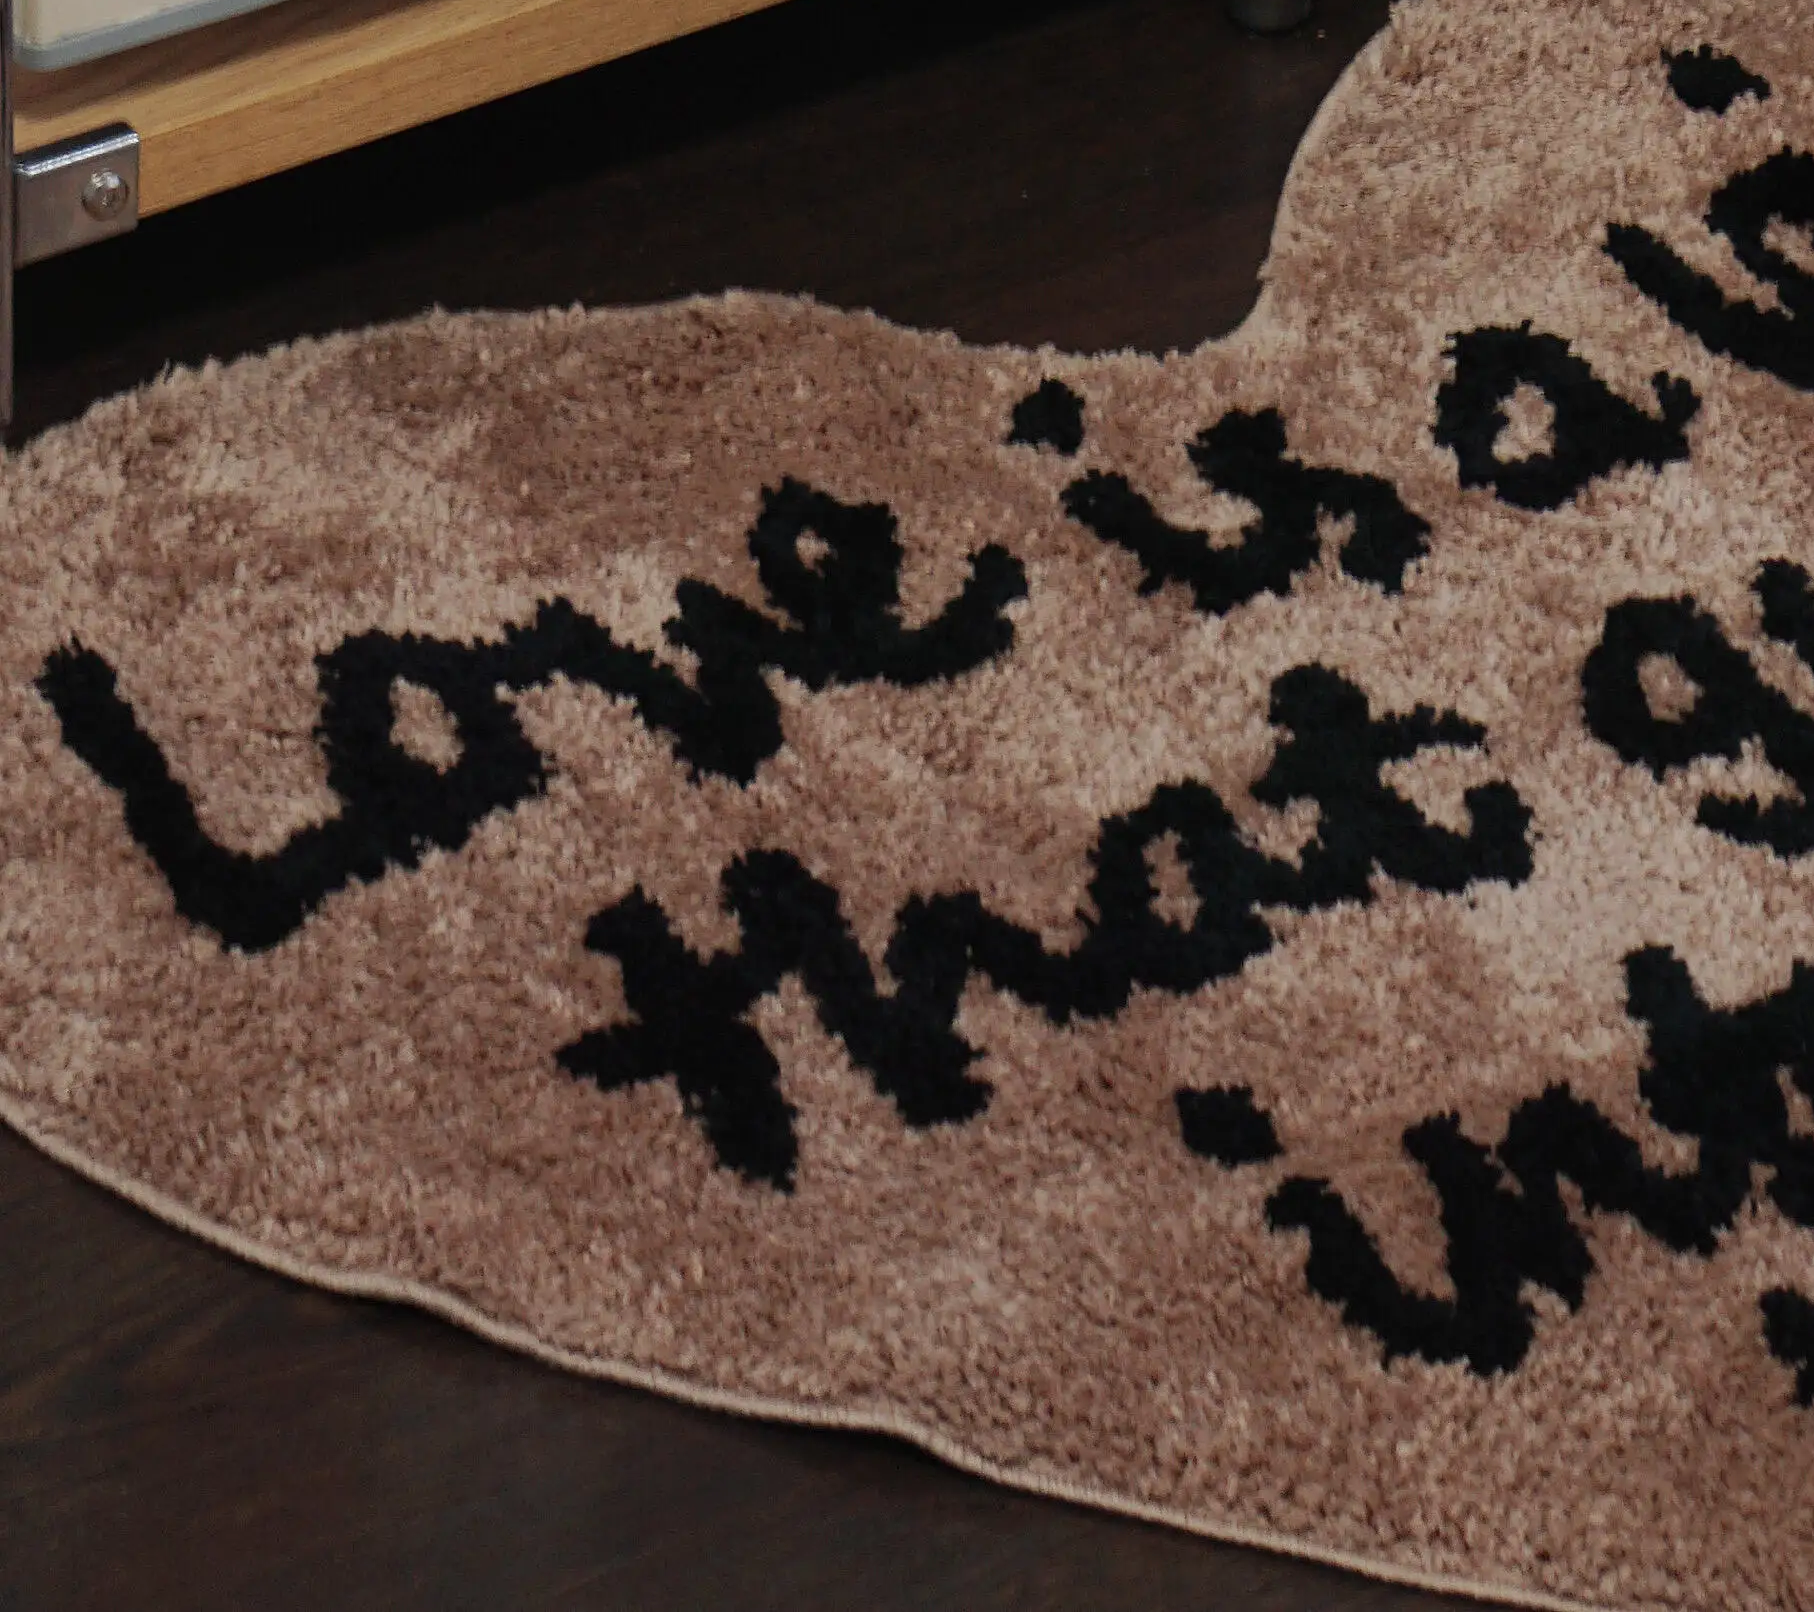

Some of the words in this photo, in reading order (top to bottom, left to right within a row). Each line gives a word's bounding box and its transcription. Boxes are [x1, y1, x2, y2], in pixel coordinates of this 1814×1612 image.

[36, 476, 1028, 953] Love
[1007, 378, 1431, 614] is
[1433, 322, 1701, 511] a
[555, 663, 1533, 1194] that
